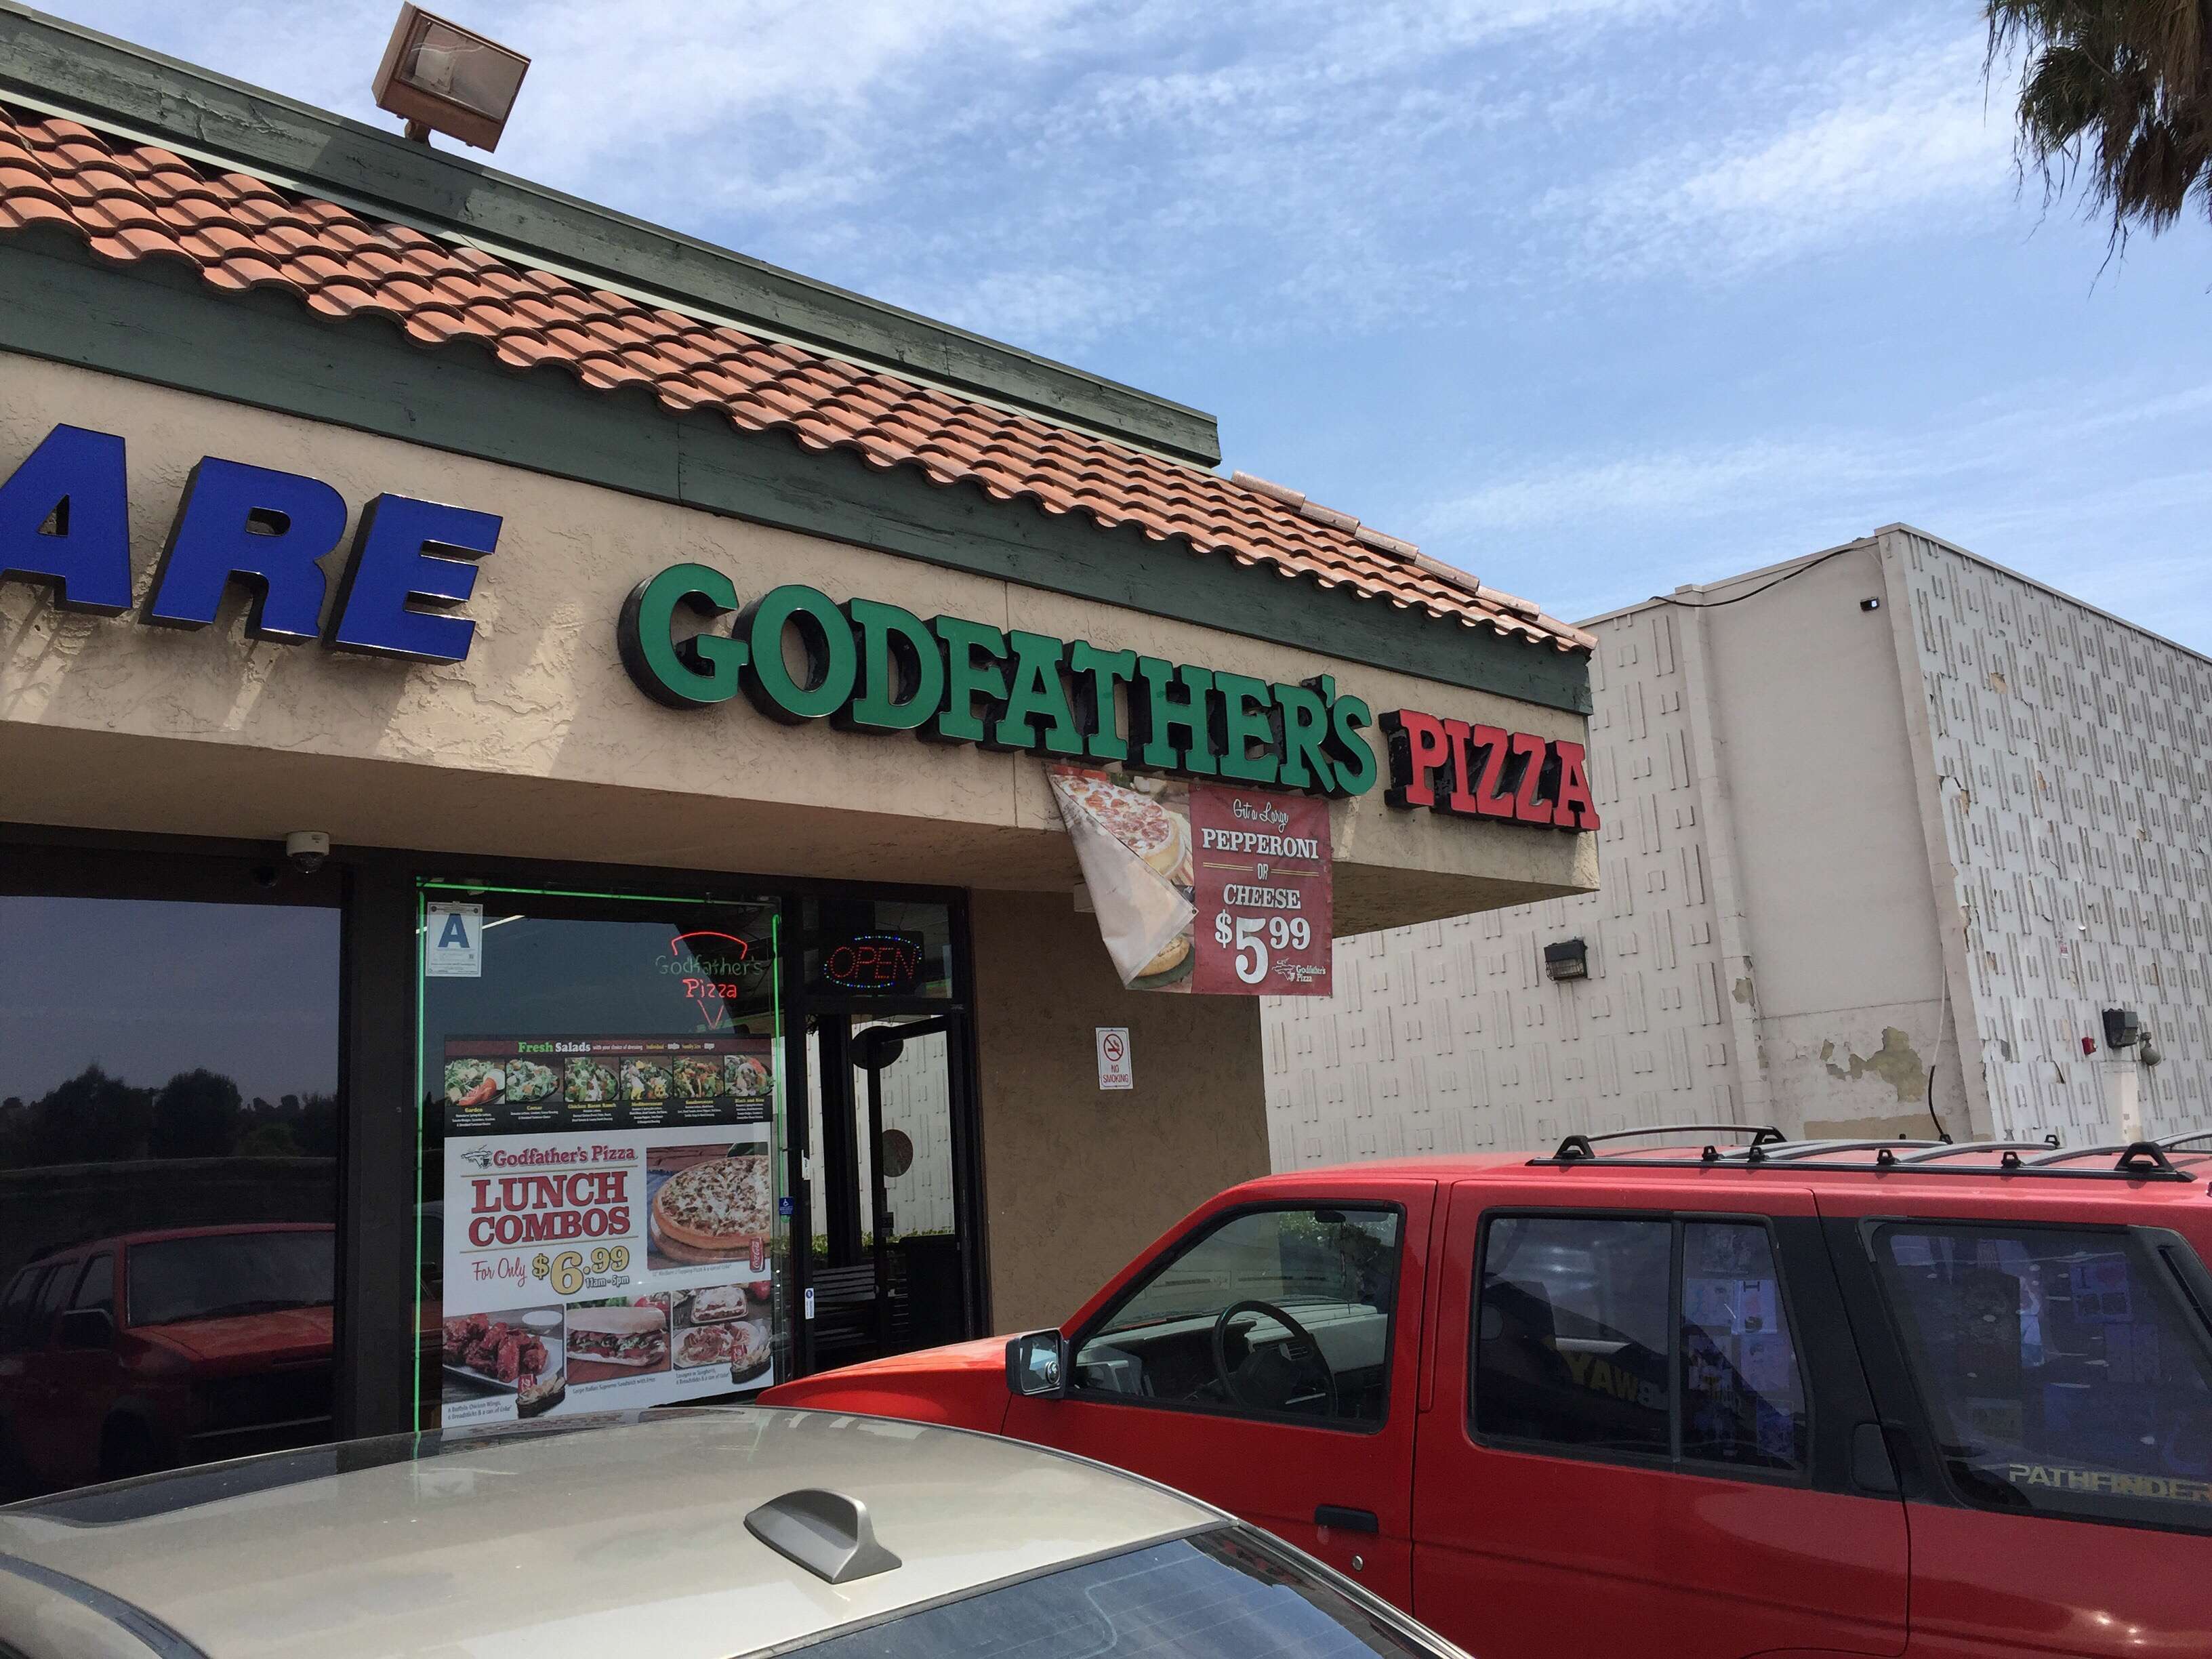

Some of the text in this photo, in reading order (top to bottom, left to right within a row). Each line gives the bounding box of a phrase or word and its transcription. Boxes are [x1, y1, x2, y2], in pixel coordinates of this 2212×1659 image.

[622, 562, 1600, 832] GODFATHER'S PIZZA
[1260, 802, 1289, 833] Large
[1201, 827, 1319, 859] PEPPERONI
[1257, 863, 1269, 880] OR
[1223, 883, 1302, 909] CHEESE
[438, 913, 470, 948] A
[655, 954, 762, 976] Godfather's
[828, 945, 917, 981] OPEN
[682, 977, 737, 998] Pizza
[518, 1042, 554, 1052] Fresh
[555, 1041, 591, 1052] Salads
[1103, 1073, 1129, 1084] SMOKING
[1111, 1065, 1120, 1073] NO
[493, 1145, 636, 1166] Godfather's Pizza
[471, 1170, 628, 1214] LUNCH
[468, 1206, 630, 1247] COMBOS
[472, 1261, 495, 1281] For
[497, 1257, 528, 1288] Only
[532, 1246, 630, 1295] $6.99
[2009, 1463, 2212, 1503] PATHFINDER
